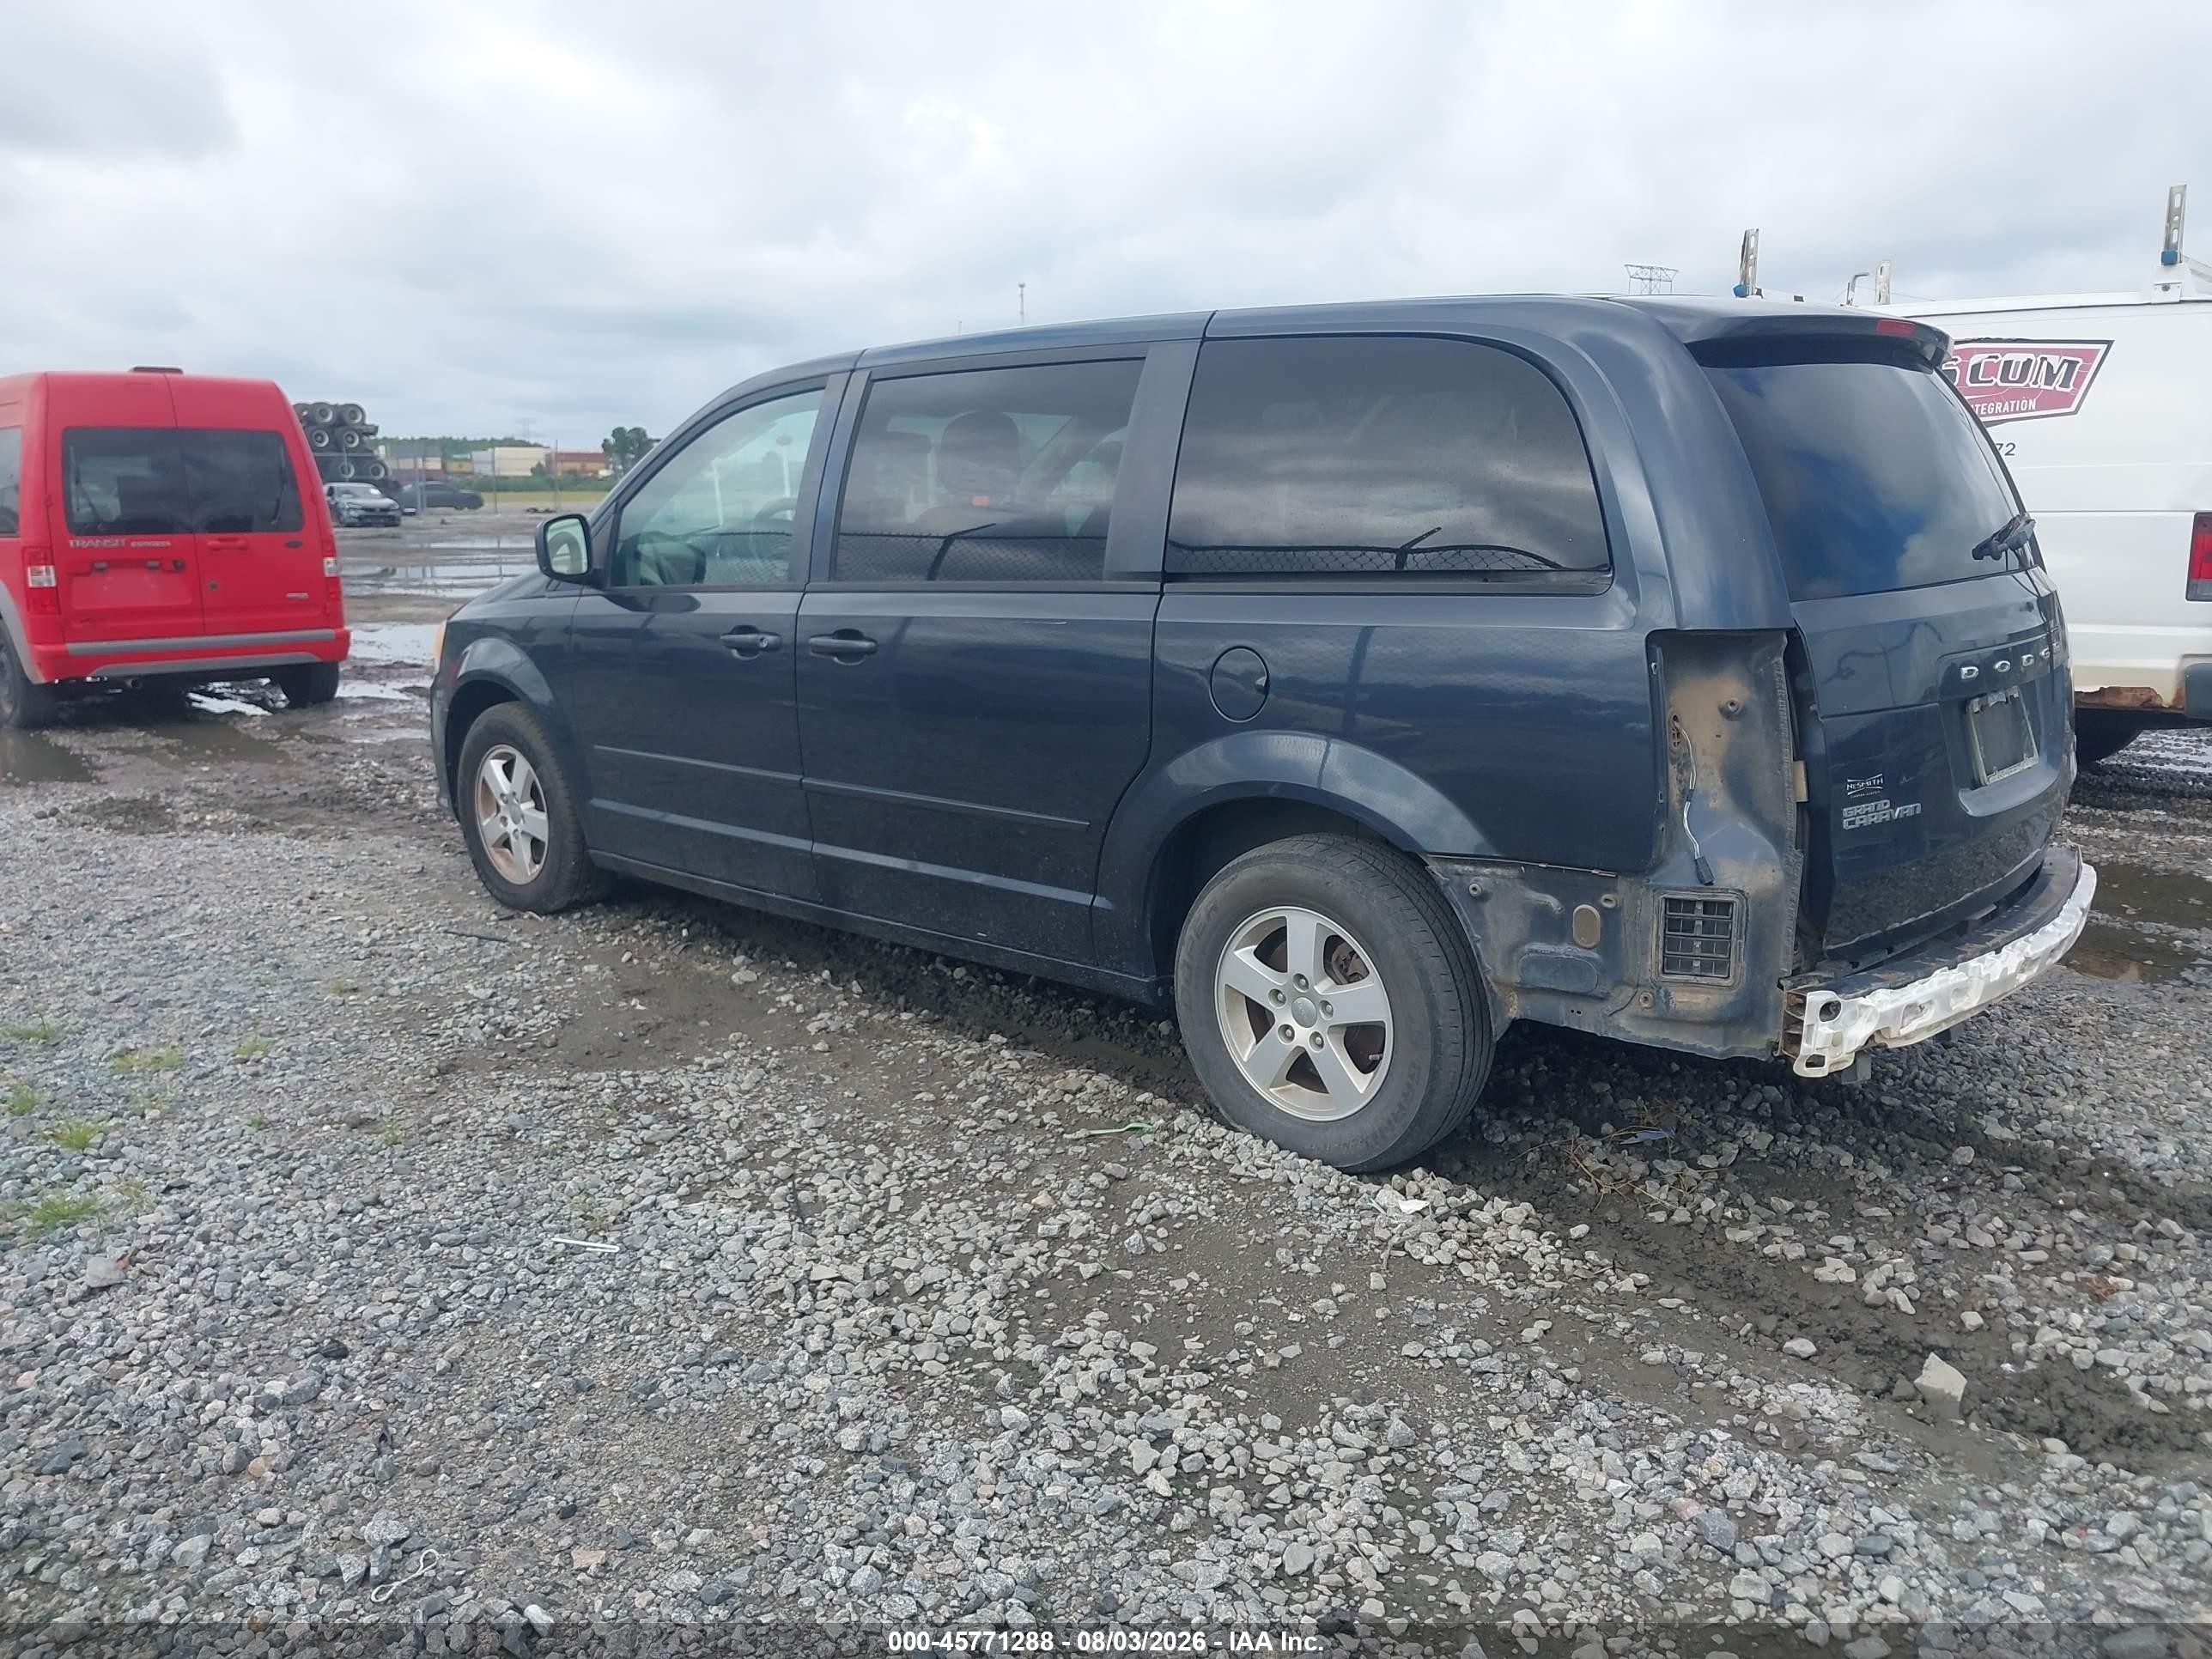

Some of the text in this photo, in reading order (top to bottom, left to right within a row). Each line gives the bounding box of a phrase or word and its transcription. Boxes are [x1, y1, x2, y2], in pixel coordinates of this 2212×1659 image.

[69, 538, 125, 548] TRANSIT
[1846, 777, 1884, 791] NESMITH
[1843, 799, 1891, 817] GRAND
[1843, 803, 1922, 830] CARAVAN
